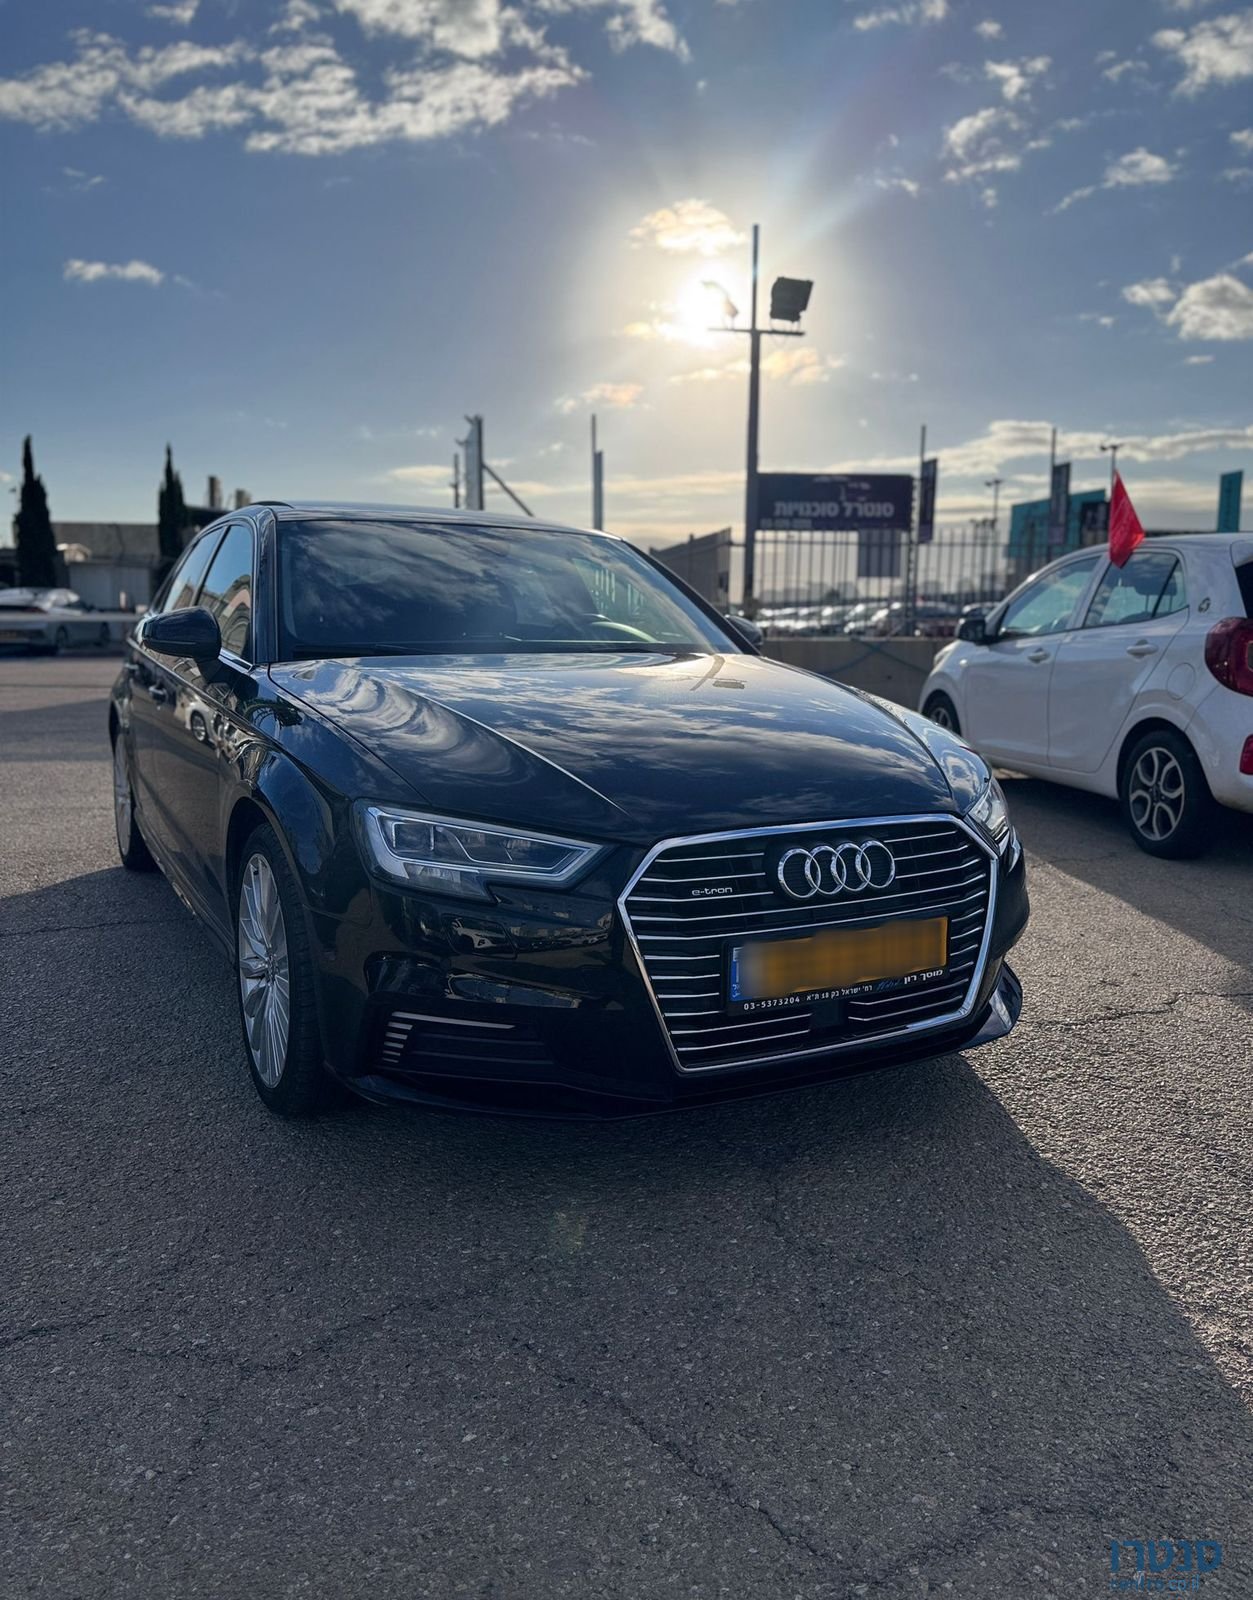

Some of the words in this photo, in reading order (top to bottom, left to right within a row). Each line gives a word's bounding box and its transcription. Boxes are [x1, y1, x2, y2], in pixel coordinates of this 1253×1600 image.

[691, 887, 733, 896] e-tron
[903, 974, 917, 985] רון
[920, 969, 943, 981] מוסך
[820, 991, 830, 999] 18
[841, 987, 861, 996] ישראל
[743, 996, 800, 1011] 03-5373204
